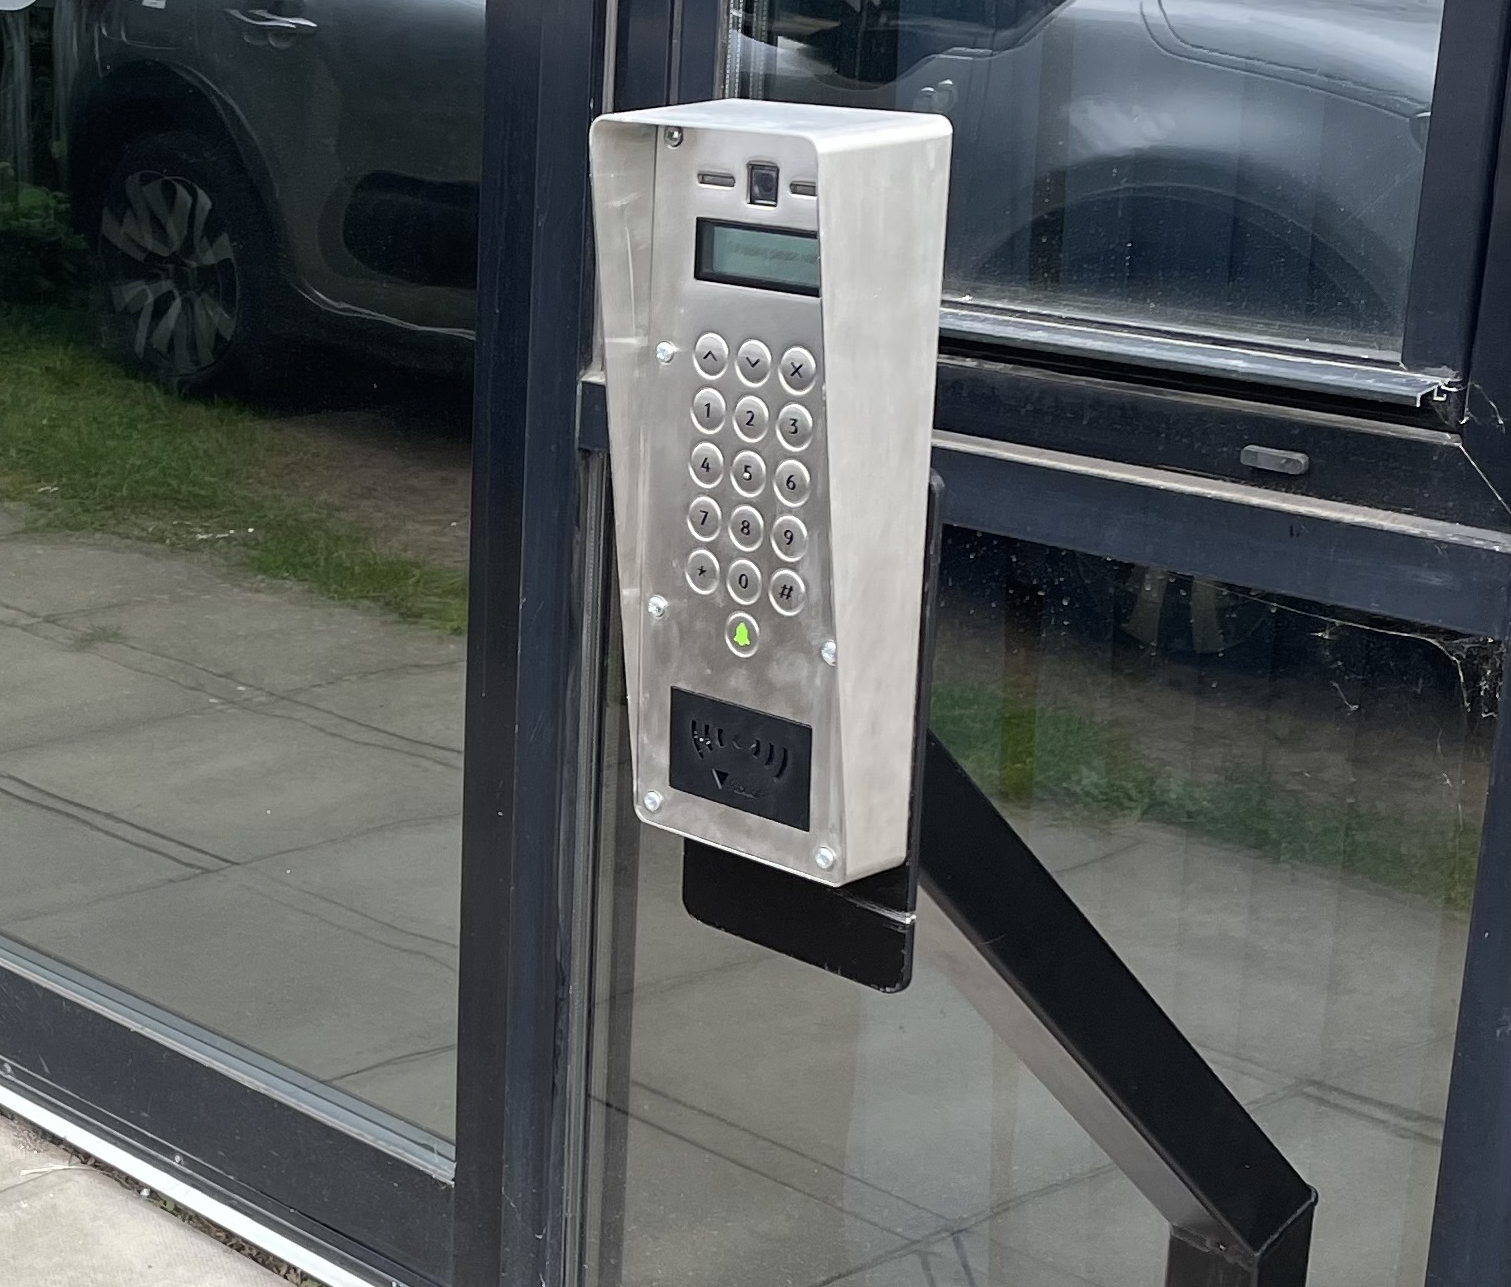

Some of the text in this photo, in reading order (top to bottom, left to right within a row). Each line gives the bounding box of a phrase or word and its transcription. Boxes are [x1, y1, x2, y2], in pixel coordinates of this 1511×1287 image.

[745, 410, 755, 427] 2
[788, 418, 798, 434] 3
[700, 456, 796, 491] 4 5 6
[699, 509, 794, 545] 7 8 9
[739, 573, 749, 590] 0
